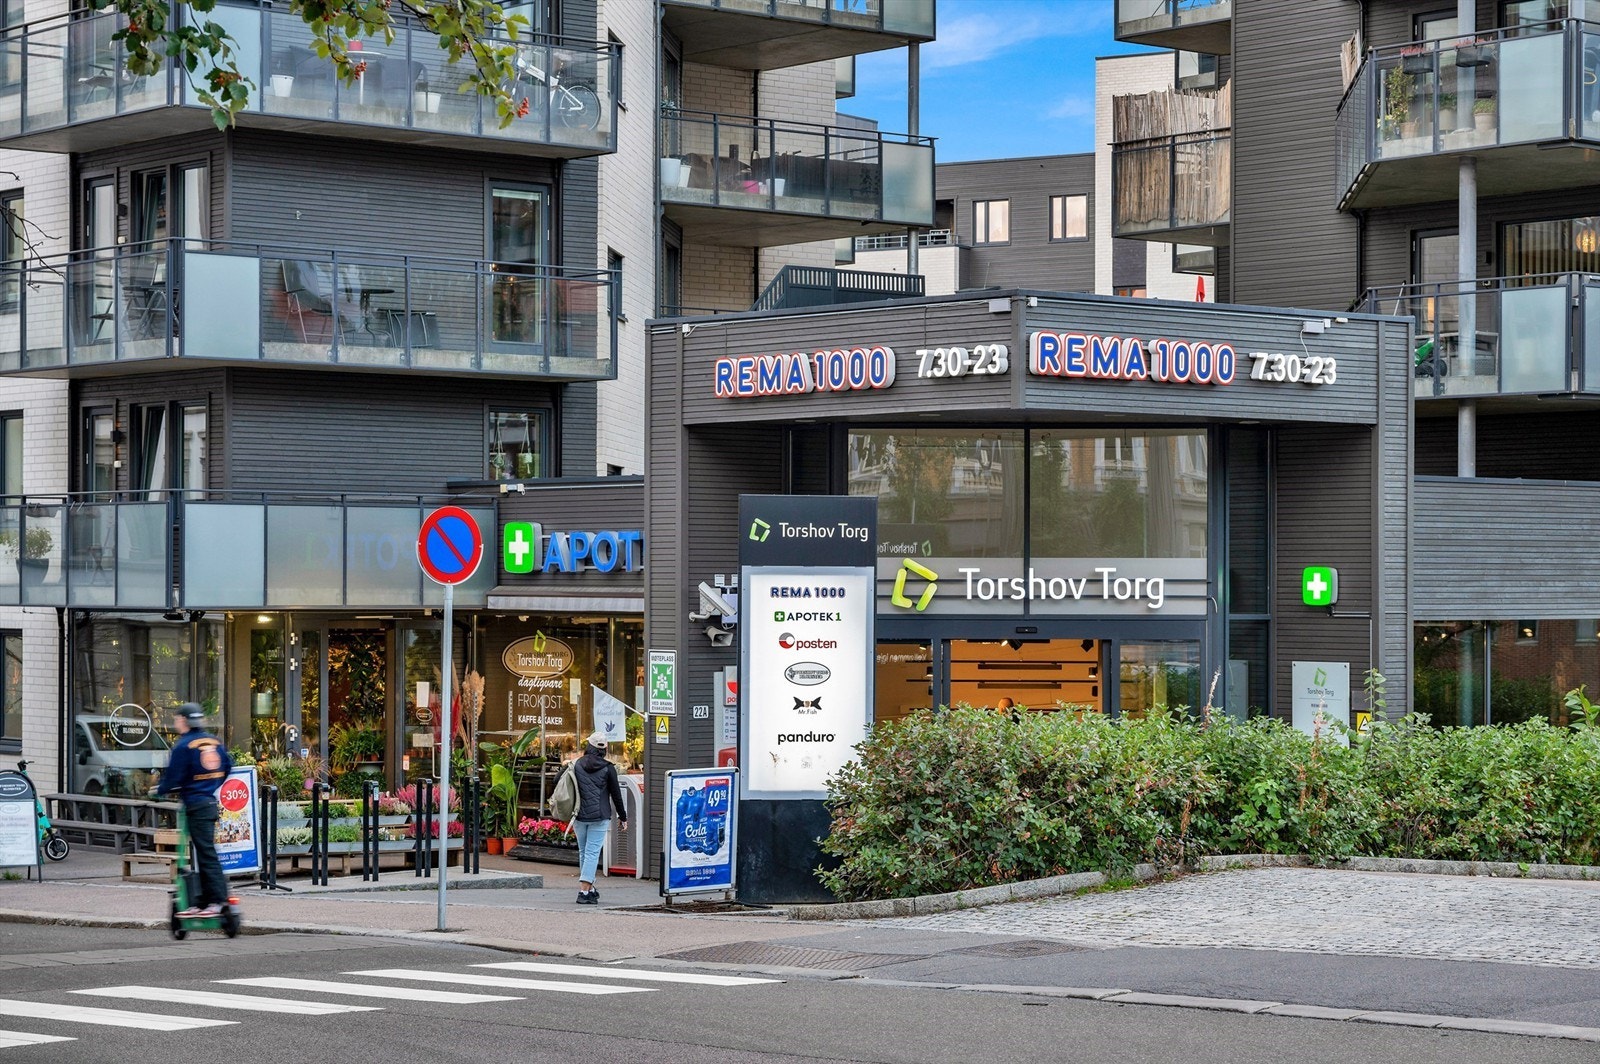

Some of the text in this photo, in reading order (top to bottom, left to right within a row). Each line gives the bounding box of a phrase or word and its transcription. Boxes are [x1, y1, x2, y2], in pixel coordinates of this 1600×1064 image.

[915, 344, 1005, 378] 7.30-23
[1035, 331, 1236, 384] REMA 1000
[715, 346, 890, 398] REMA 1000
[1249, 351, 1337, 384] 7.30-23
[779, 522, 869, 542] Torshov Torg
[543, 530, 644, 573] APOT
[770, 586, 846, 598] REMA 1000
[958, 567, 1165, 609] Torshov Torg
[786, 612, 842, 622] APOTEK 1
[796, 638, 838, 651] posten
[517, 653, 562, 671] Torshov Torg
[518, 694, 563, 709] FROKOST
[518, 715, 537, 724] KAFFE
[694, 707, 708, 717] 22A
[778, 731, 835, 745] panduro
[222, 789, 248, 800] -30%
[708, 789, 721, 807] 49
[685, 823, 707, 838] Cola
